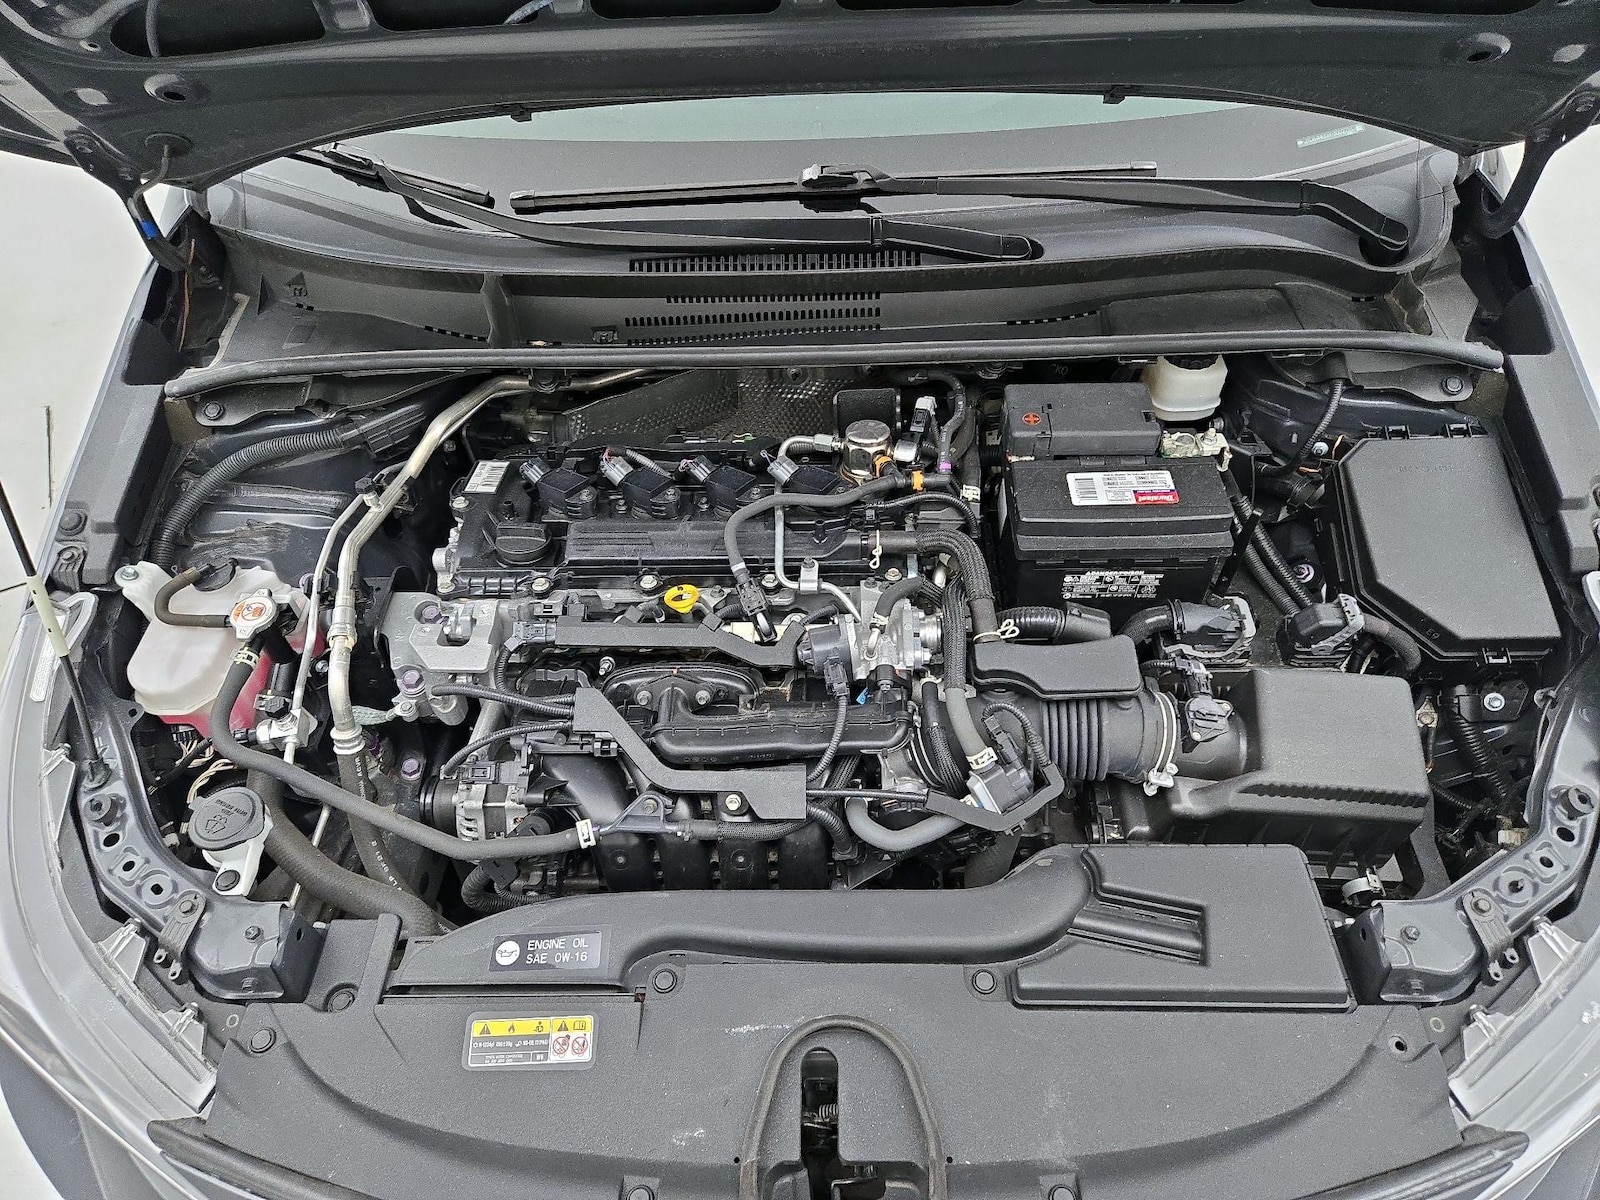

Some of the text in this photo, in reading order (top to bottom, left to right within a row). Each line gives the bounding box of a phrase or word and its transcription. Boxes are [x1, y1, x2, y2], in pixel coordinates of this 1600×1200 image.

[527, 937, 589, 951] ENGINE OIL
[525, 951, 588, 964] SAE 0W-16
